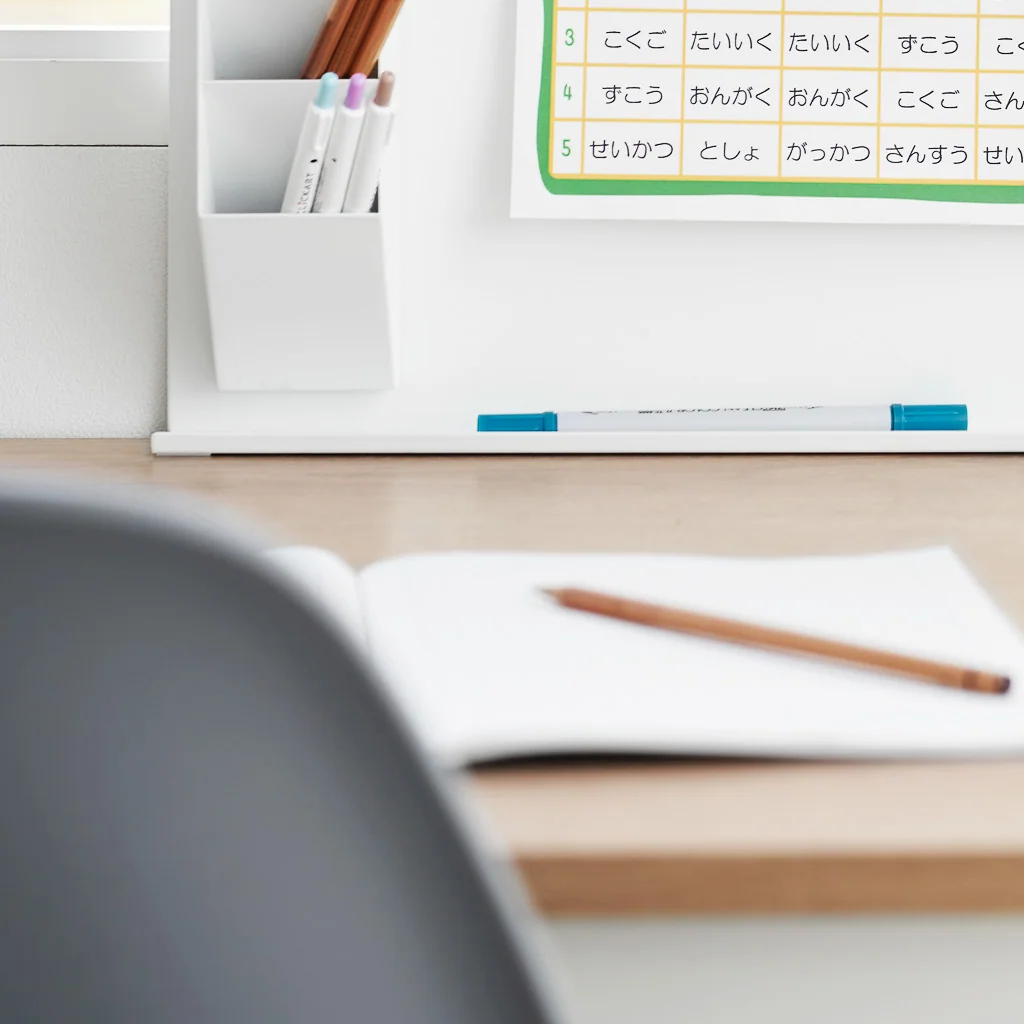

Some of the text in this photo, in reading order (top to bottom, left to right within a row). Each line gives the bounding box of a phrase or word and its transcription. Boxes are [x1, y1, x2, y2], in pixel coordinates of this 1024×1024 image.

[563, 27, 575, 47] 3
[604, 29, 667, 50] こくご
[690, 30, 772, 52] たいいく
[788, 32, 870, 54] たいいく
[897, 34, 959, 55] ずこう
[562, 82, 573, 101] 4
[601, 84, 663, 105] ずこう
[689, 85, 771, 107] おんがく
[788, 87, 869, 108] おんがく
[897, 89, 960, 110] こくご
[560, 138, 572, 158] 5
[589, 139, 674, 159] せいかつ
[699, 140, 760, 162] としょ
[786, 141, 869, 162] がっかつ
[885, 144, 967, 165] さんすう
